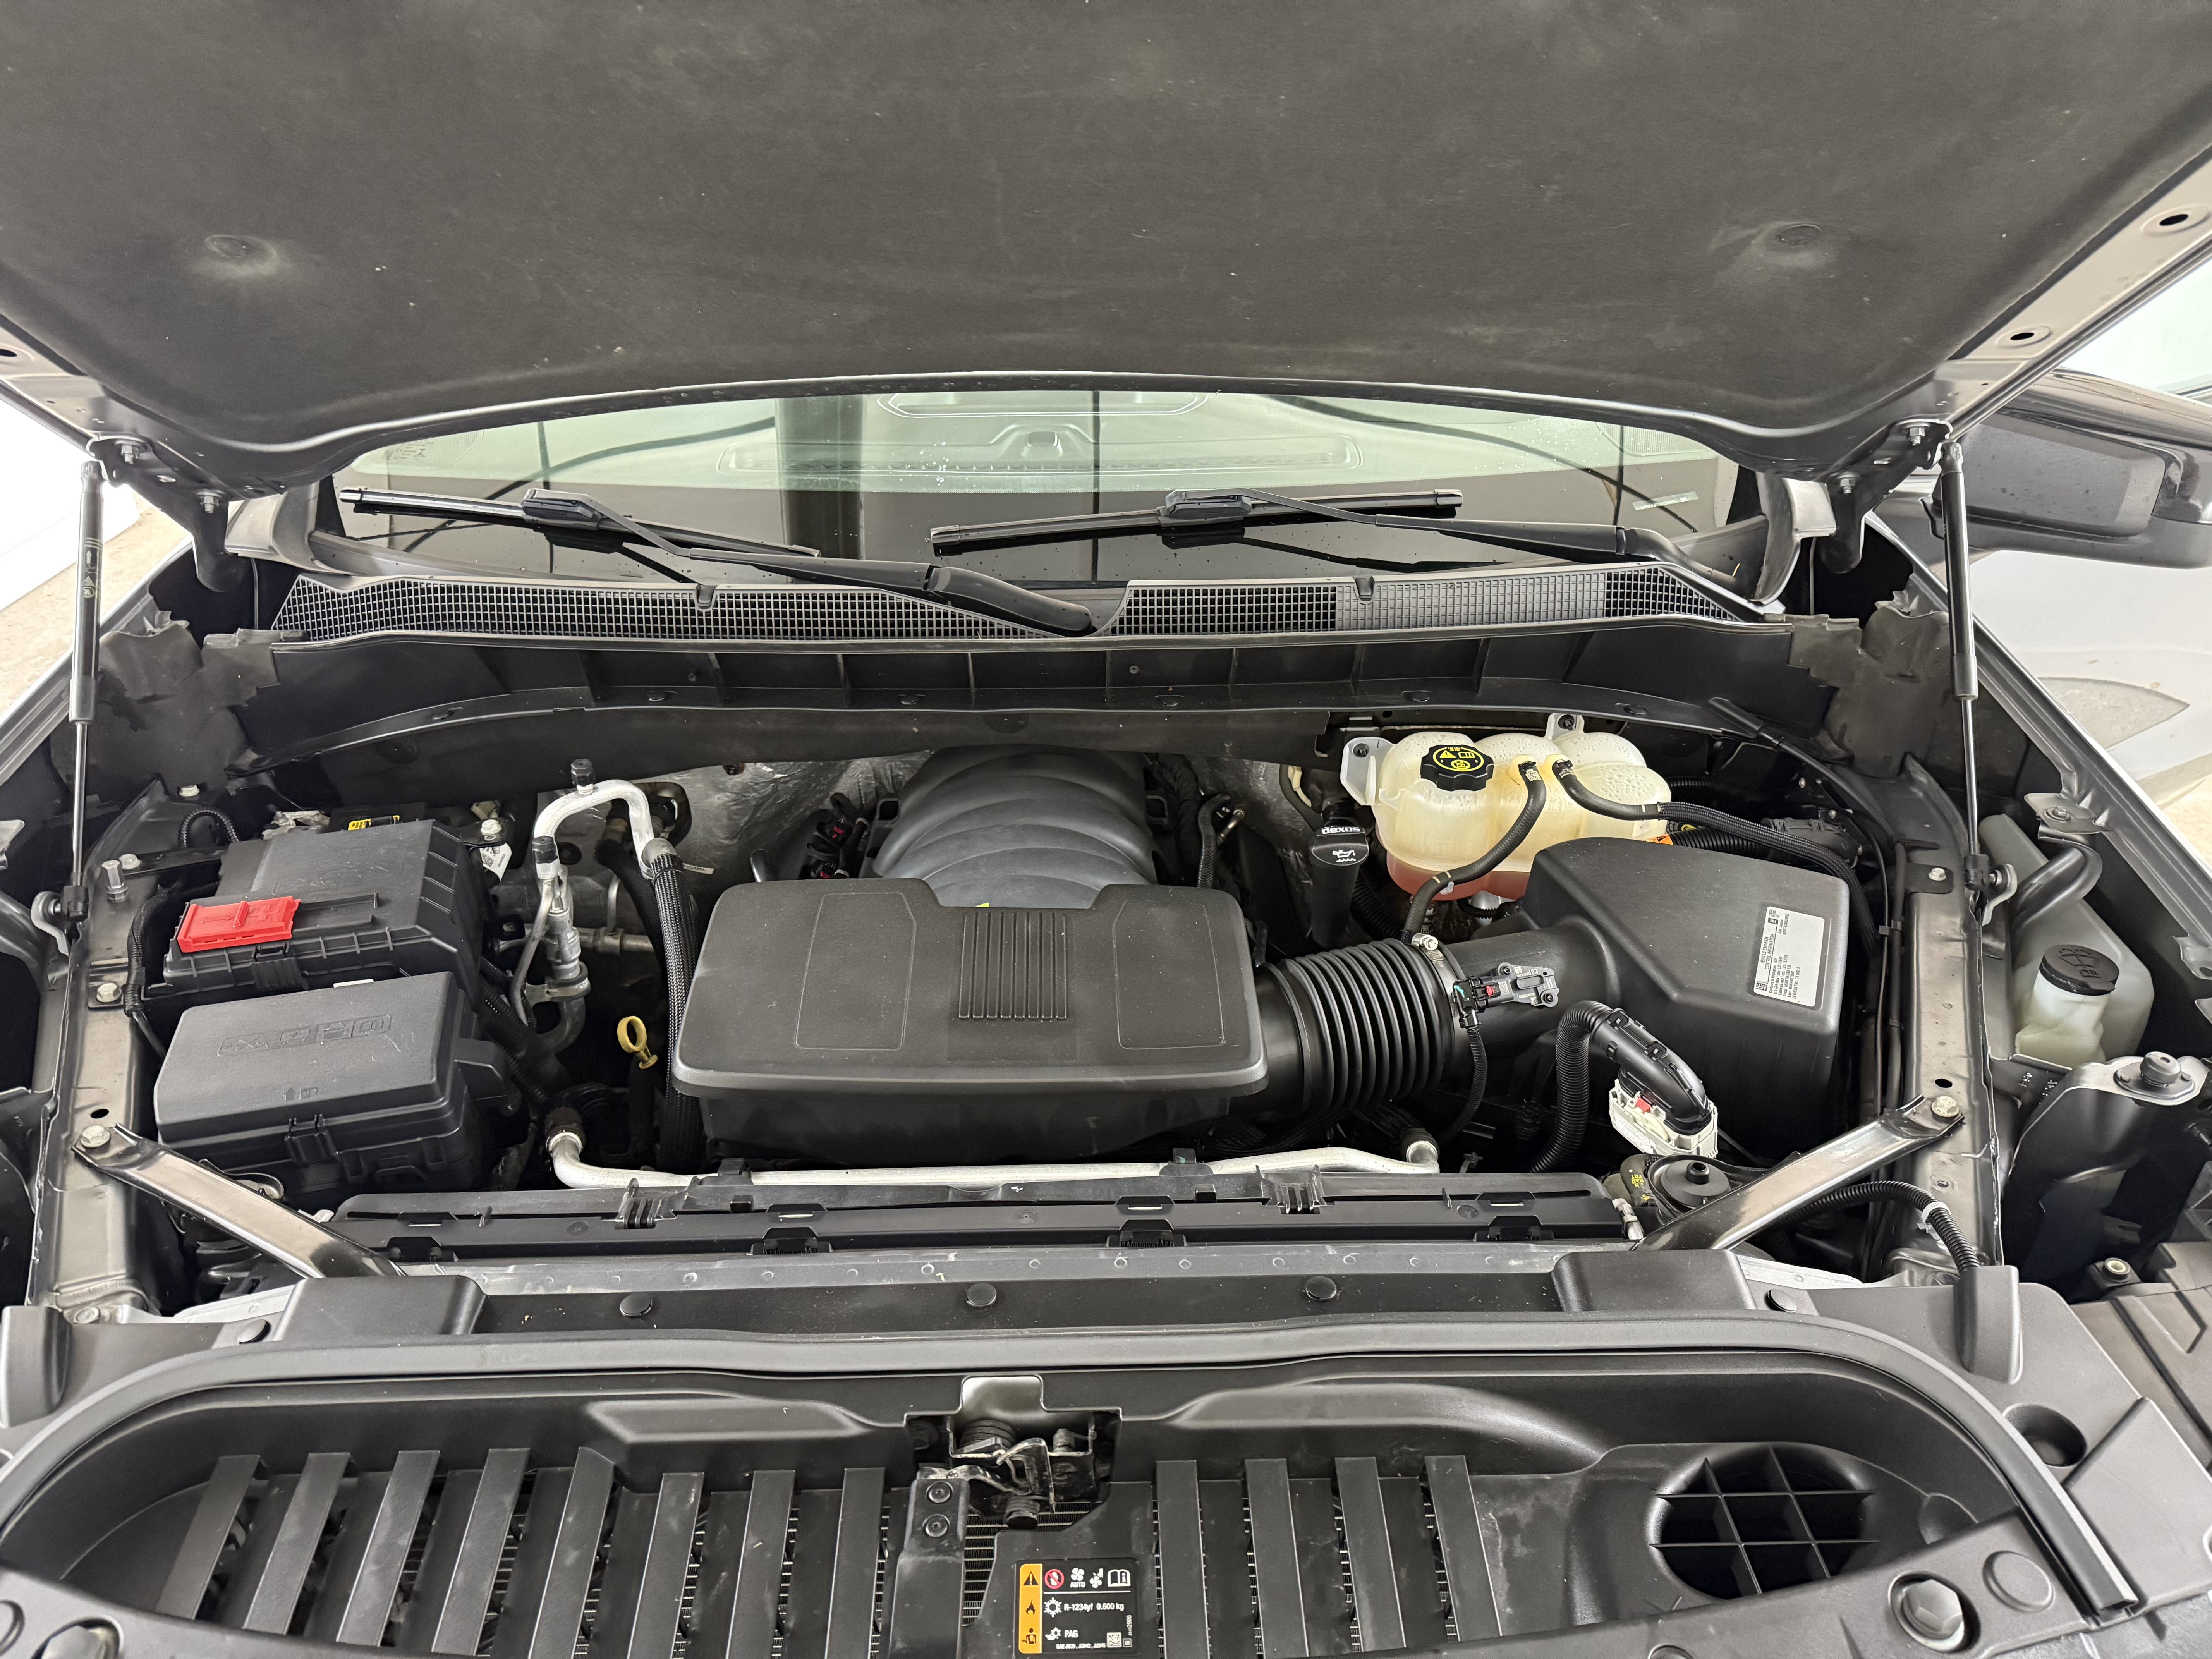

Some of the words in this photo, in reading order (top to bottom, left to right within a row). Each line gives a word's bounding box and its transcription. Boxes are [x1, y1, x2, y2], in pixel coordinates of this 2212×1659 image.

[1064, 1603, 1094, 1612] R-1234yf
[1096, 1602, 1115, 1611] 0.600
[1116, 1602, 1125, 1611] kg
[1064, 1630, 1079, 1638] PAG
